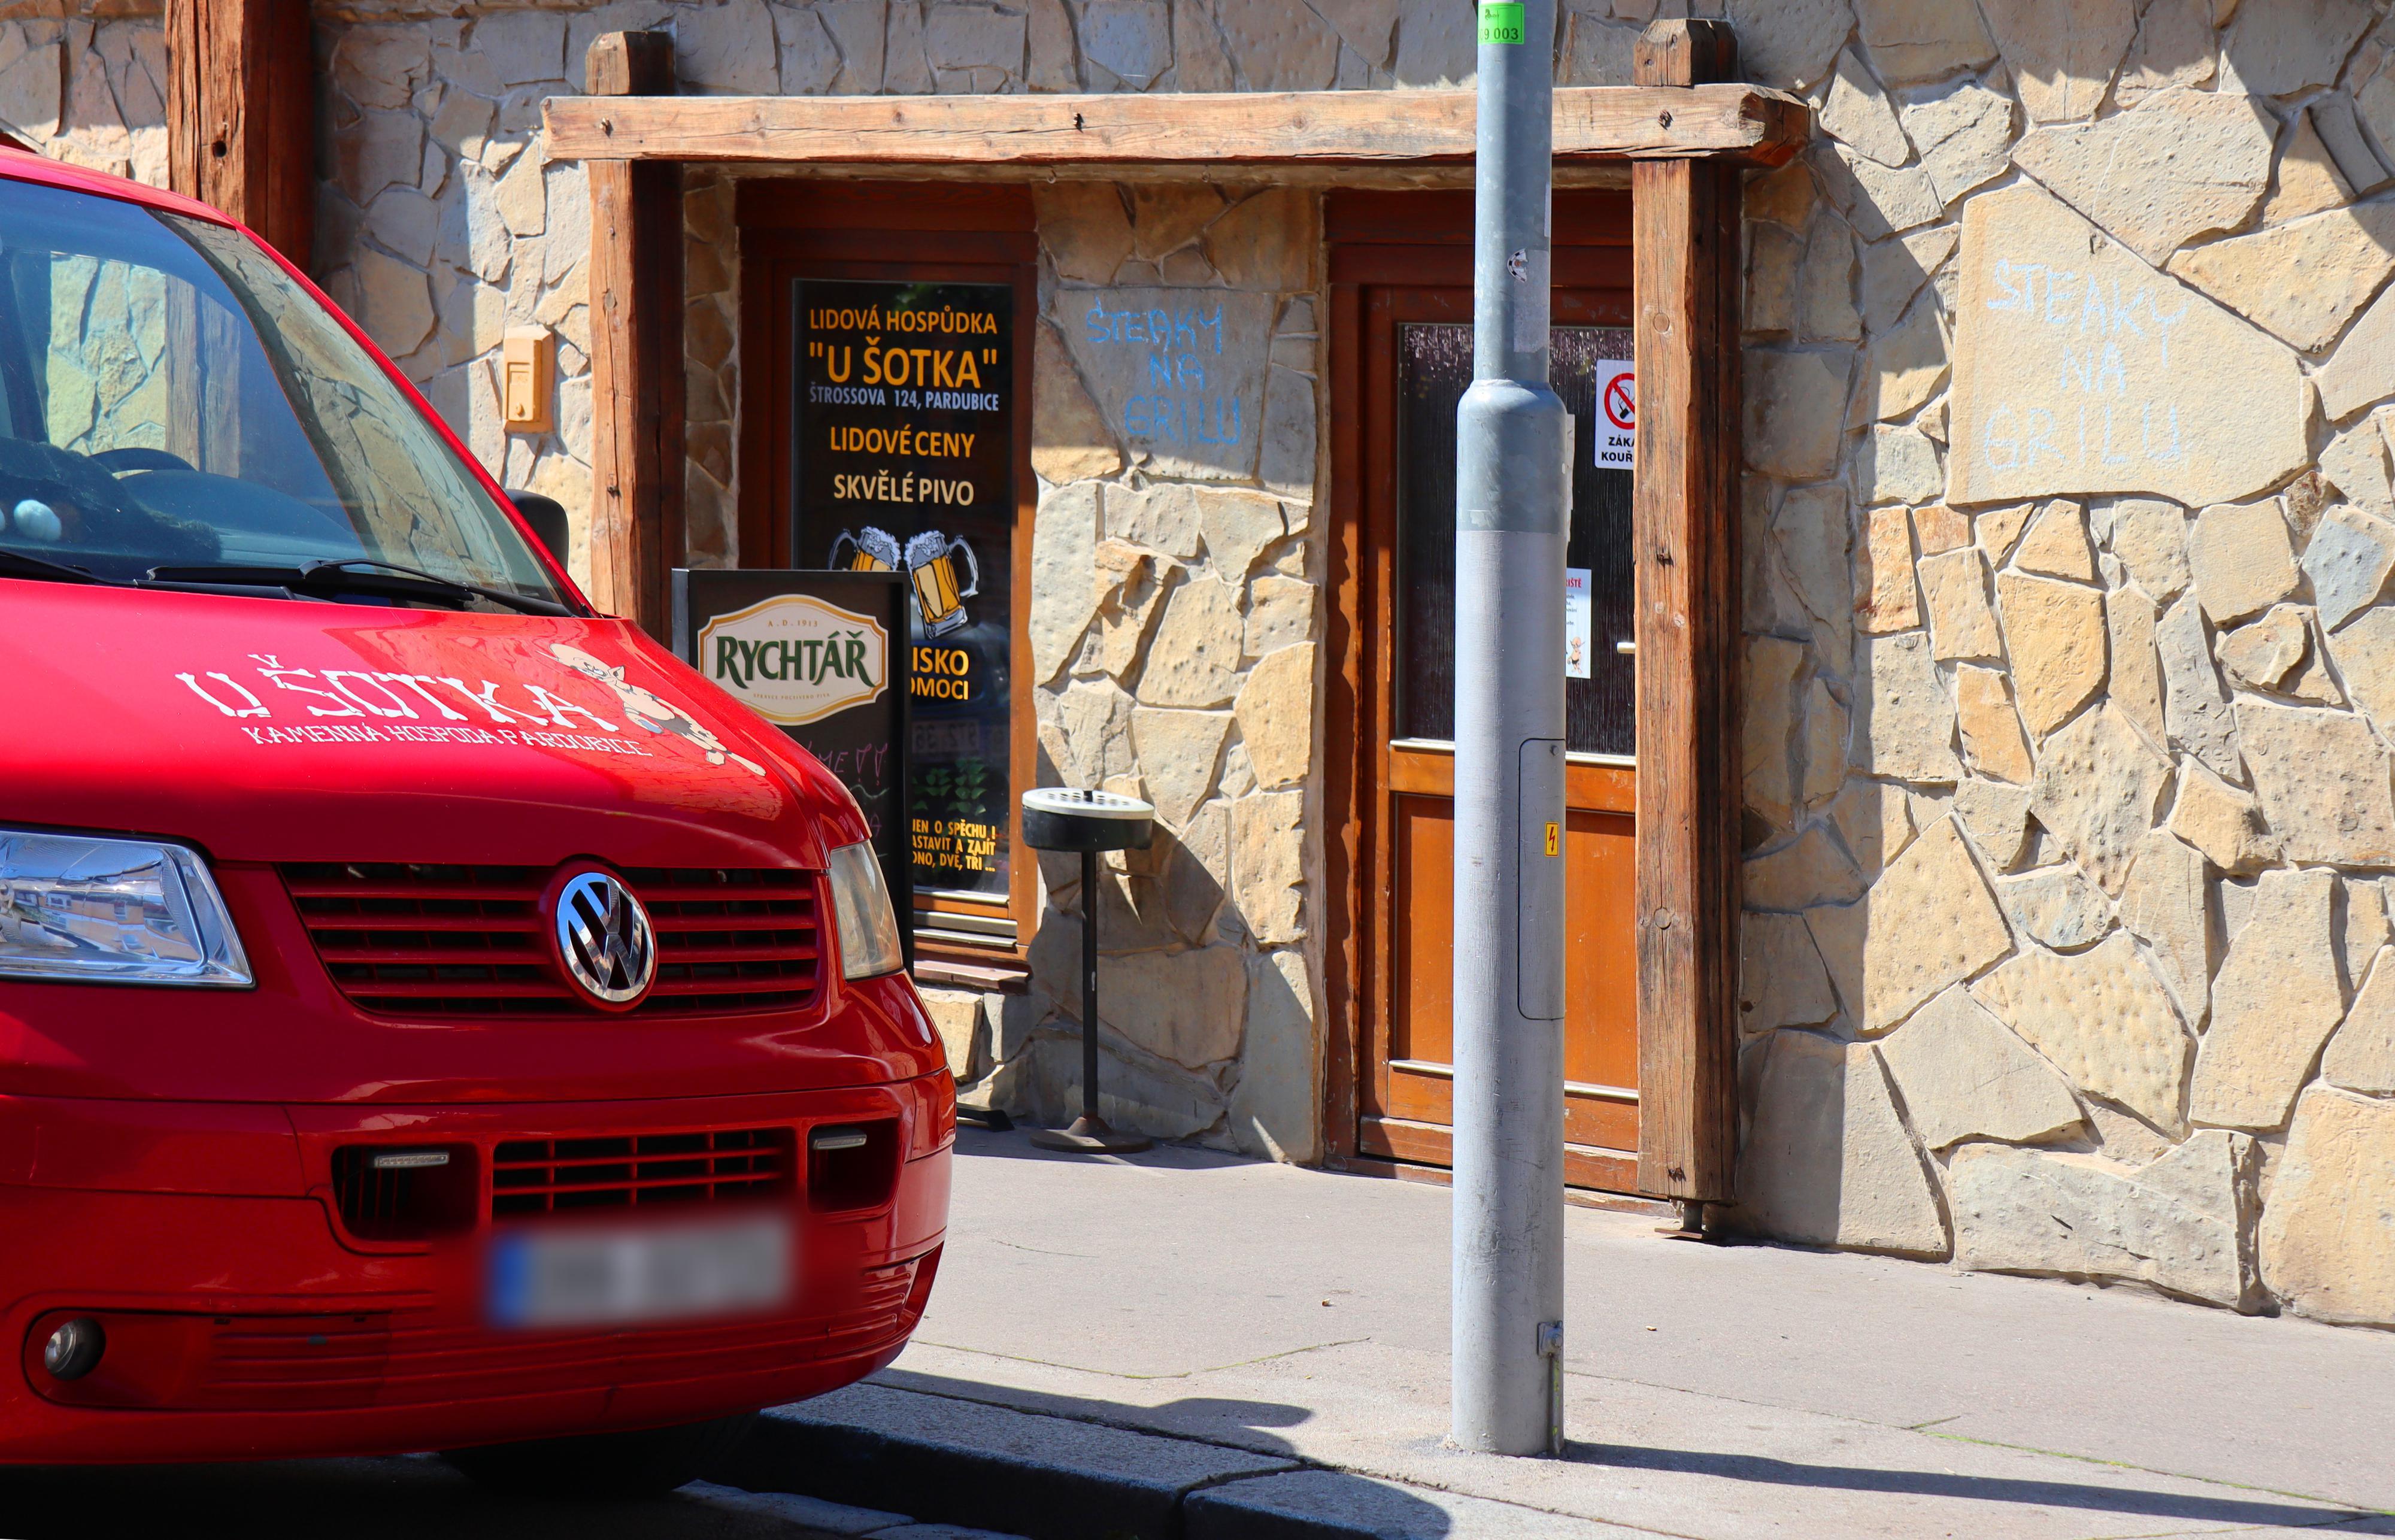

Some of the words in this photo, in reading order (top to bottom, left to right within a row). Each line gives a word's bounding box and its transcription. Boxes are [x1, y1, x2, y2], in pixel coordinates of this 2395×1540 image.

[1494, 28, 1519, 40] 003
[810, 304, 881, 330] LIDOVÁ
[887, 305, 998, 334] HOSPŮDKA
[1987, 258, 2188, 369] STEAKY
[1150, 351, 1205, 392] NA
[2060, 341, 2127, 396] NA
[810, 381, 886, 406] ŠTROSSOVA
[895, 390, 921, 410] 124,
[926, 391, 999, 411] PARDUBICE
[830, 424, 911, 455] LIDOVÉ
[915, 431, 975, 458] CENY
[1984, 401, 2182, 471] GRILU
[1601, 450, 1633, 463] KOUŘ
[833, 469, 914, 503] SKVĚLÉ
[919, 478, 974, 506] PIVO
[716, 630, 875, 689] RYCHTÁŘ
[912, 647, 969, 676] ISKO
[175, 671, 272, 718] U
[247, 654, 620, 732] ŠOTKA
[384, 724, 502, 744] HOSPODA
[496, 728, 654, 757] PARDUBICE
[934, 820, 942, 834] O
[948, 819, 987, 839] SPĚCHU
[955, 839, 963, 853] A
[968, 837, 996, 856] ZAJÍT
[965, 853, 982, 871] TŘI
